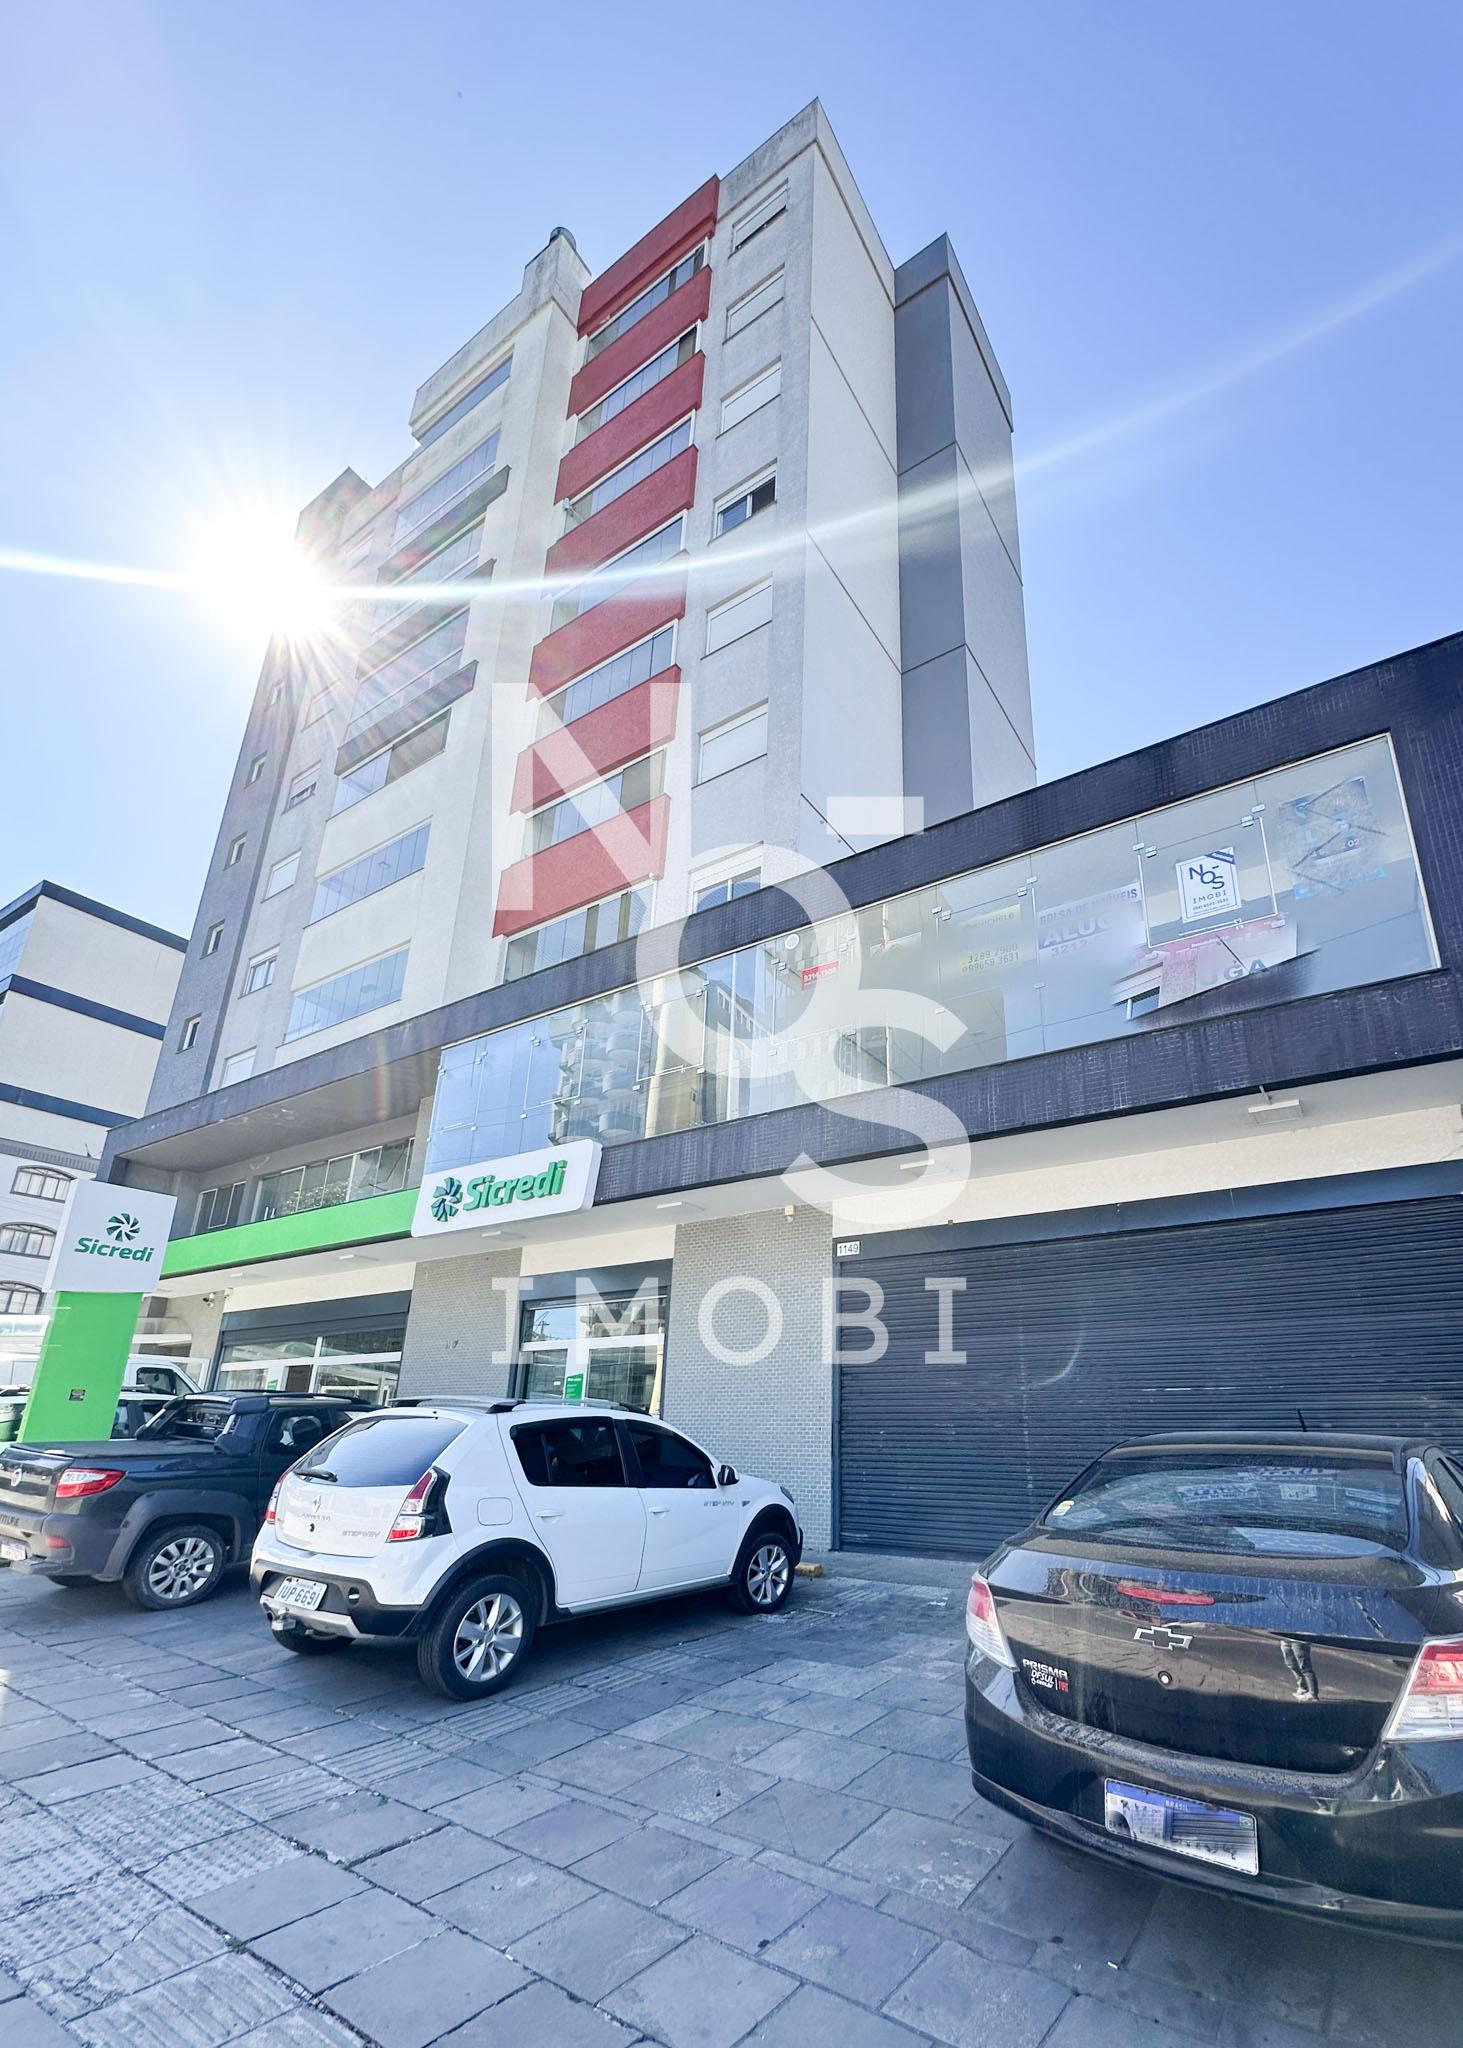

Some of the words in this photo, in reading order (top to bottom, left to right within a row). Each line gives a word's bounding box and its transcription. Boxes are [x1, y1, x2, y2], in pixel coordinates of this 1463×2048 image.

[462, 1159, 568, 1211] Sicredi
[74, 1236, 155, 1263] Sicredi
[838, 1243, 859, 1255] 1149
[1022, 1658, 1069, 1681] PRISMA
[1165, 1799, 1189, 1812] BRASIL
